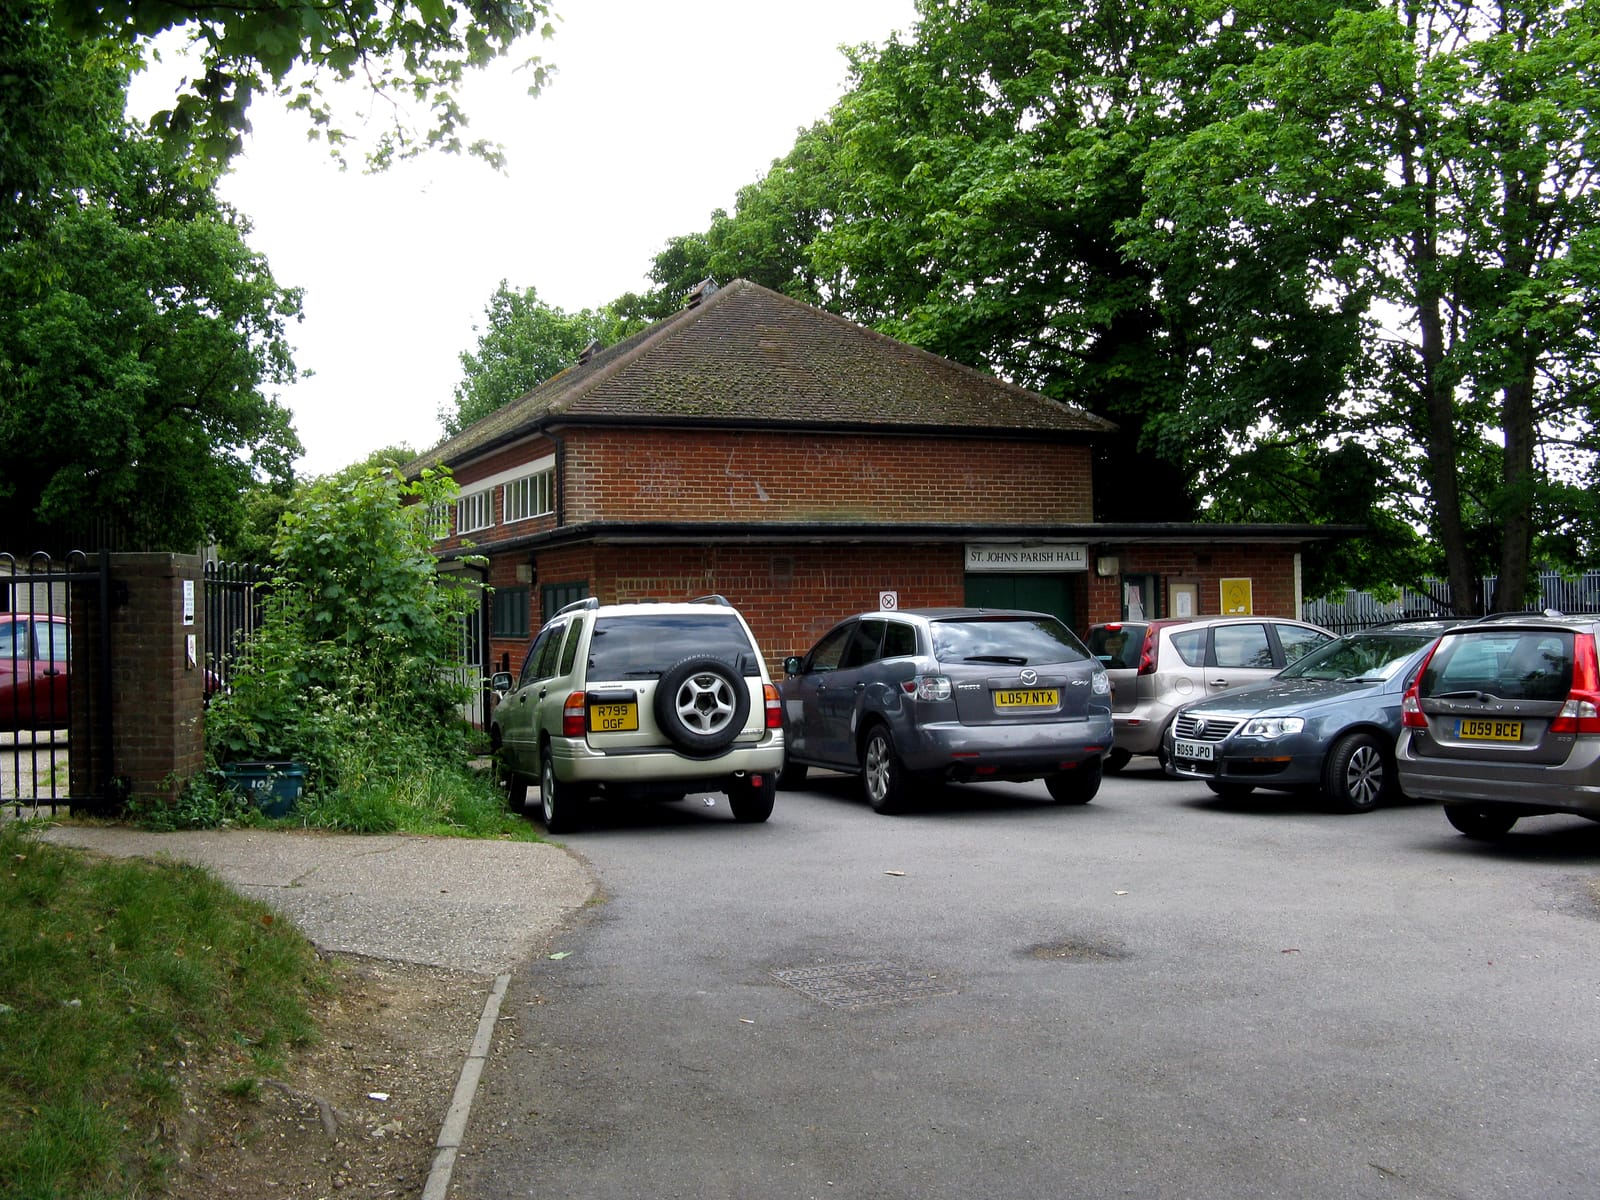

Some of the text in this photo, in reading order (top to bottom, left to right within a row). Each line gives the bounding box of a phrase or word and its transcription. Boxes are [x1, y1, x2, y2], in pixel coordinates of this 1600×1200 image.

[971, 551, 1082, 562] ST. JOHN'S PARISH HALL
[1000, 691, 1054, 704] LD57 NTX
[598, 705, 628, 717] R799
[1461, 721, 1519, 737] LD59 BCE
